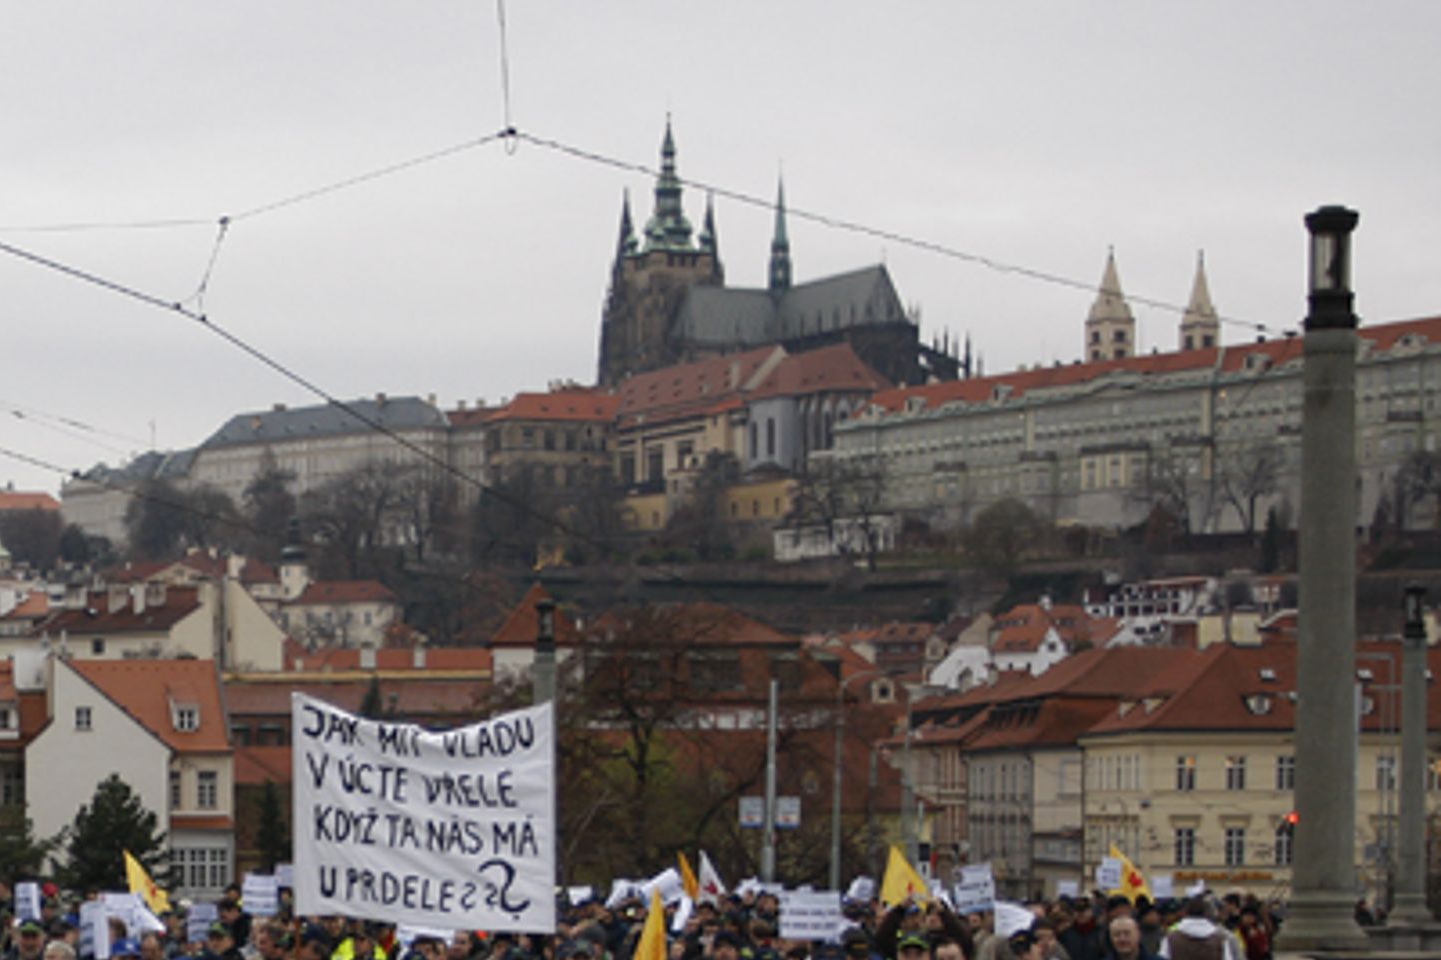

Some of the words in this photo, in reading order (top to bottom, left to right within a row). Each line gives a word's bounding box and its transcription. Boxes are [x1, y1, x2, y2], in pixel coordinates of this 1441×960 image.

[302, 704, 363, 746] JAK
[307, 752, 329, 789] V
[314, 804, 379, 844] KDYŽ
[385, 813, 420, 848] TA
[426, 814, 484, 855] NÁS
[492, 815, 539, 856] MÁ
[319, 865, 337, 898] U
